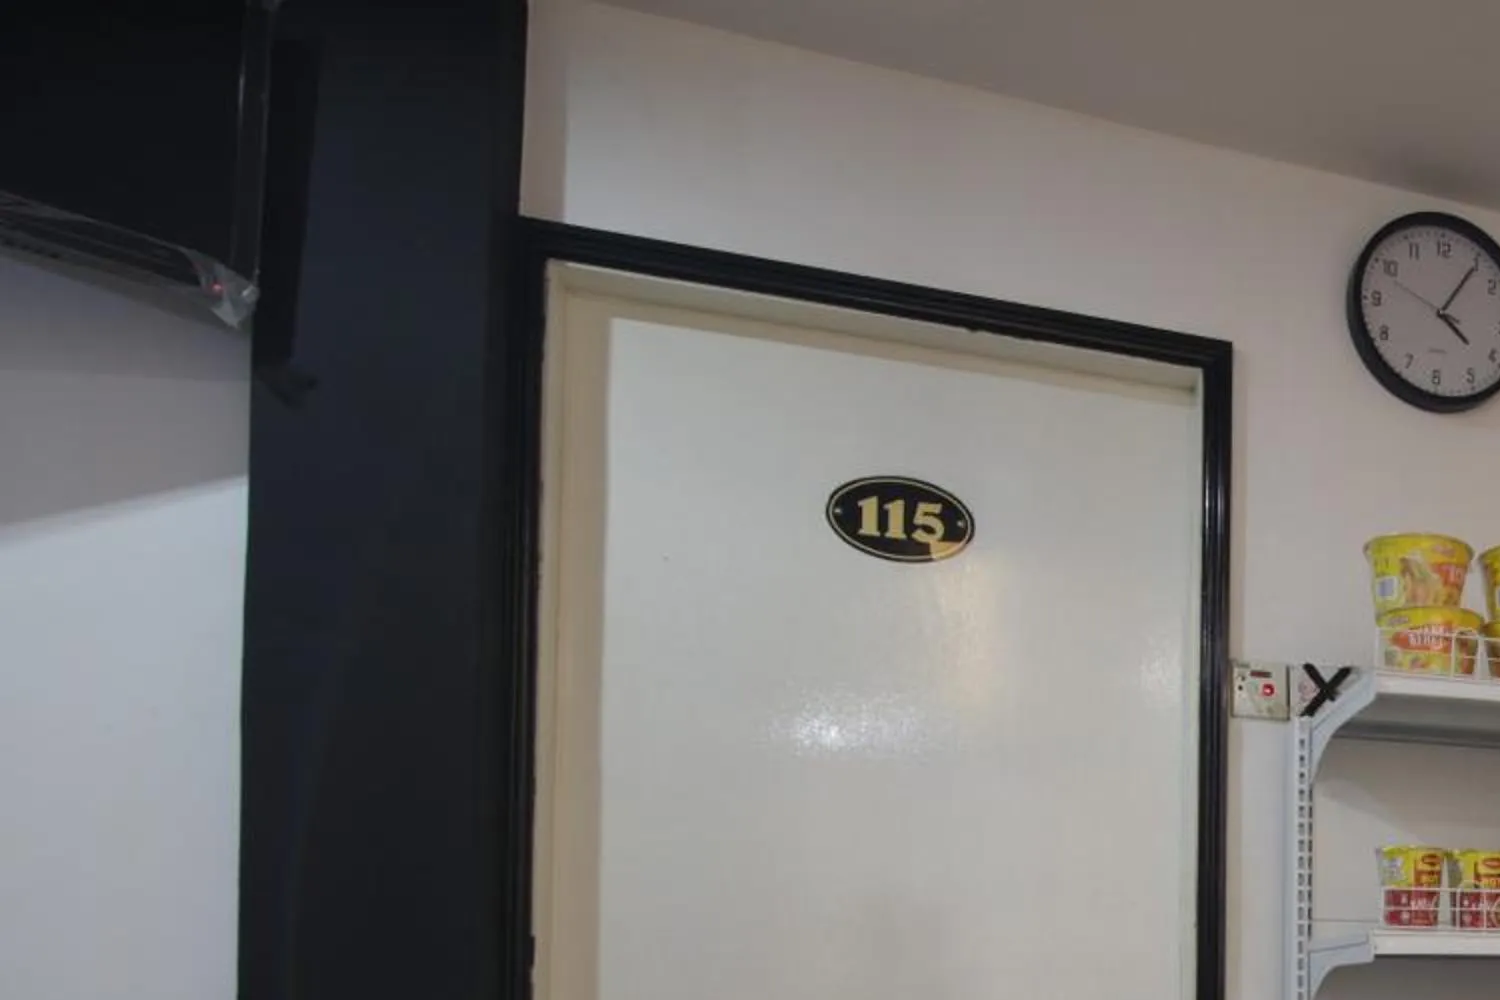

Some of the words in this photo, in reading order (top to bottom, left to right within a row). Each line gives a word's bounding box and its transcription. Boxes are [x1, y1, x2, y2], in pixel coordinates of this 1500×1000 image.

[1408, 242, 1420, 260] 11
[1436, 241, 1452, 258] 12
[1383, 259, 1398, 277] 10
[1487, 279, 1497, 295] 2
[1371, 290, 1382, 306] 9
[1379, 326, 1389, 341] 8
[1405, 353, 1415, 369] 7
[1431, 370, 1441, 385] 6
[1466, 368, 1475, 384] 5
[857, 495, 946, 543] 115
